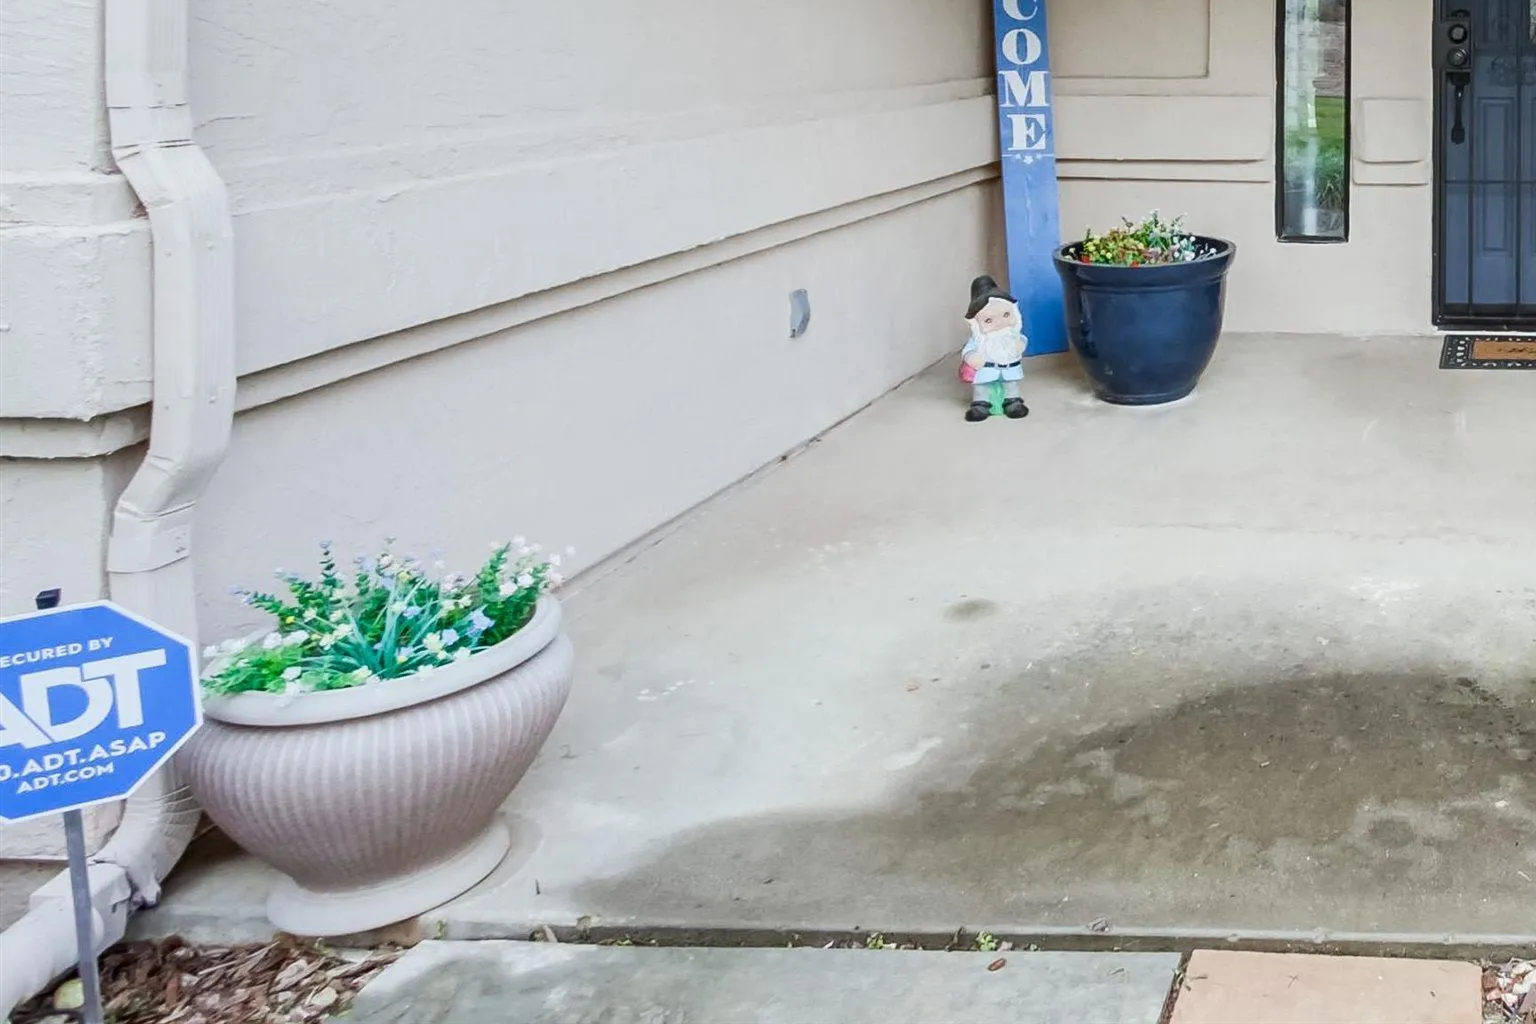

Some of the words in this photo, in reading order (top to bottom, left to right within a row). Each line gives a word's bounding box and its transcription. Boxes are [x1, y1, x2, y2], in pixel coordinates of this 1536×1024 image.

[0, 642, 83, 668] ECURED
[87, 636, 114, 652] BY
[0, 648, 167, 749] ADT
[16, 762, 114, 794] ADT.COM
